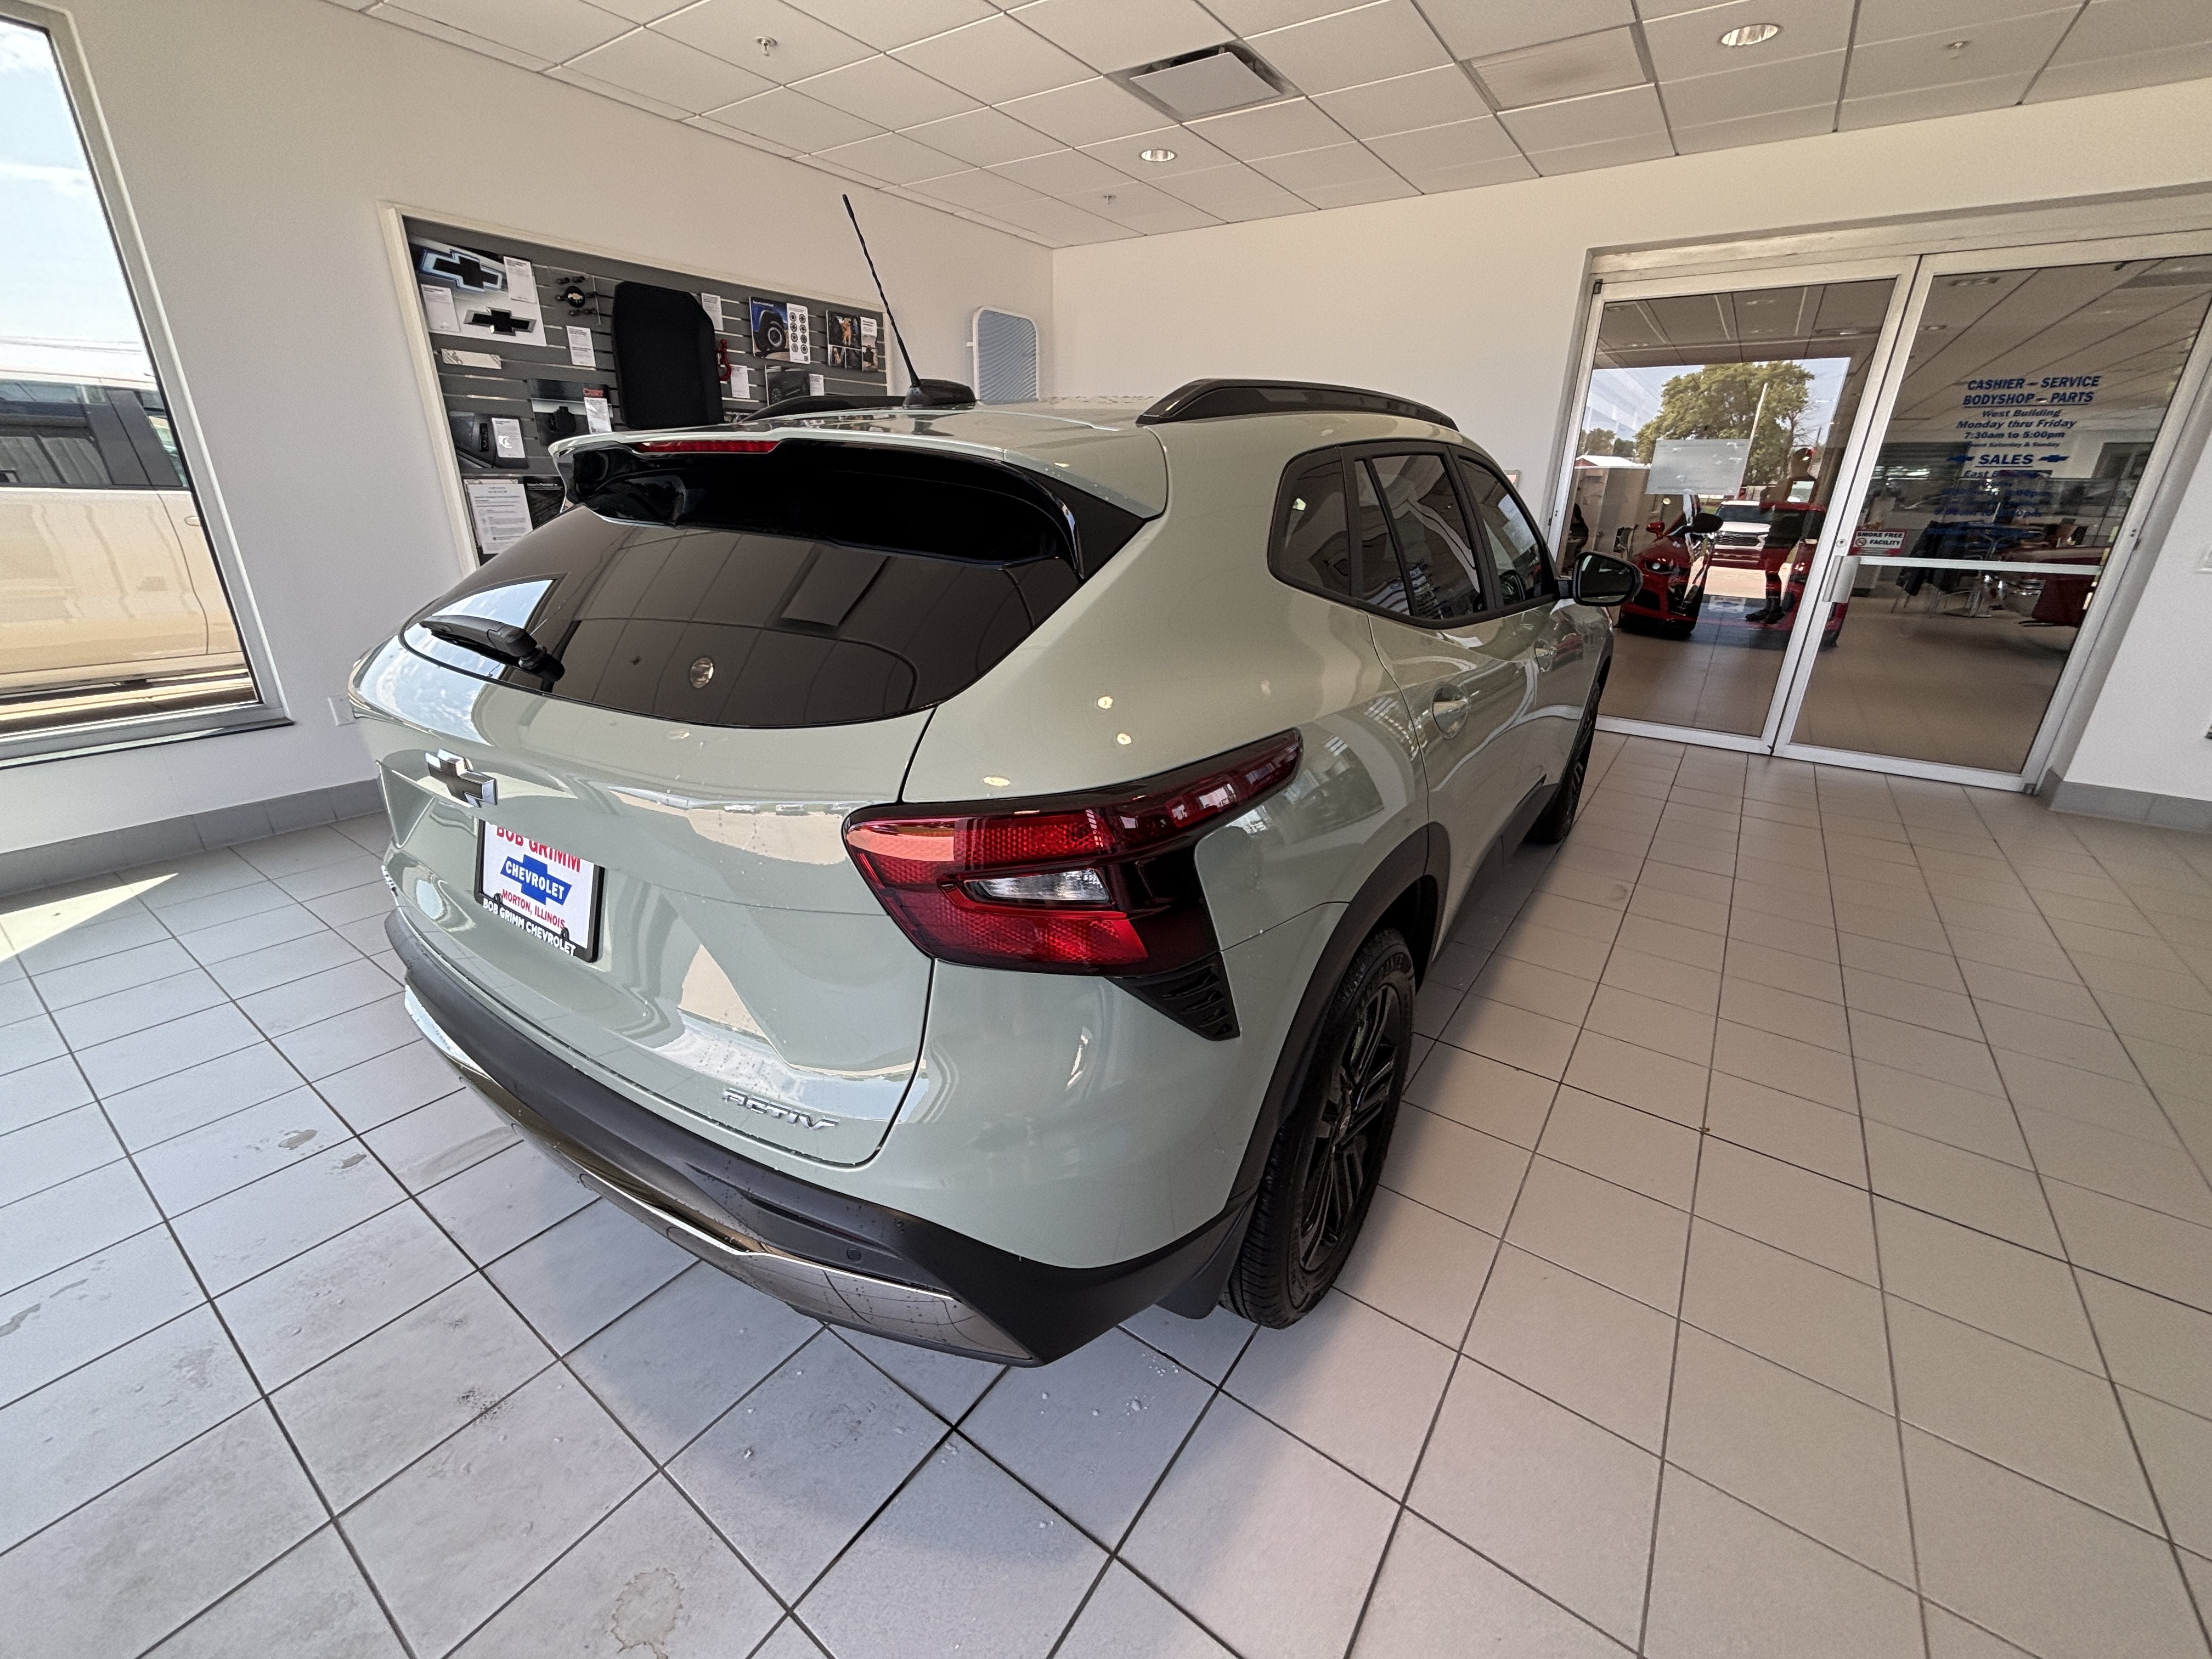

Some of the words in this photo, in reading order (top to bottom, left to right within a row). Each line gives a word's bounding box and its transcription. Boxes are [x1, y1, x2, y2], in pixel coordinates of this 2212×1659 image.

[1967, 379, 2025, 390] CASHIER
[2040, 376, 2101, 388] SERVICE
[1962, 393, 2035, 405] BODYSHOP
[2050, 391, 2094, 403] PARTS
[1982, 409, 2010, 417] West
[2013, 409, 2063, 418] Building
[1956, 420, 2005, 430] Monday
[2008, 420, 2033, 428] thru
[2035, 419, 2078, 429] Friday
[2022, 431, 2066, 439] 5:00pm
[1978, 454, 2034, 465] SALES
[505, 860, 565, 900] CHEVROLET
[501, 889, 532, 916] MORTON,
[534, 907, 565, 929] ILLINOIS
[483, 897, 499, 915] BOB
[499, 907, 525, 930] GRIMM
[526, 921, 576, 956] CHEVROLET
[722, 1088, 840, 1130] ACTIV
